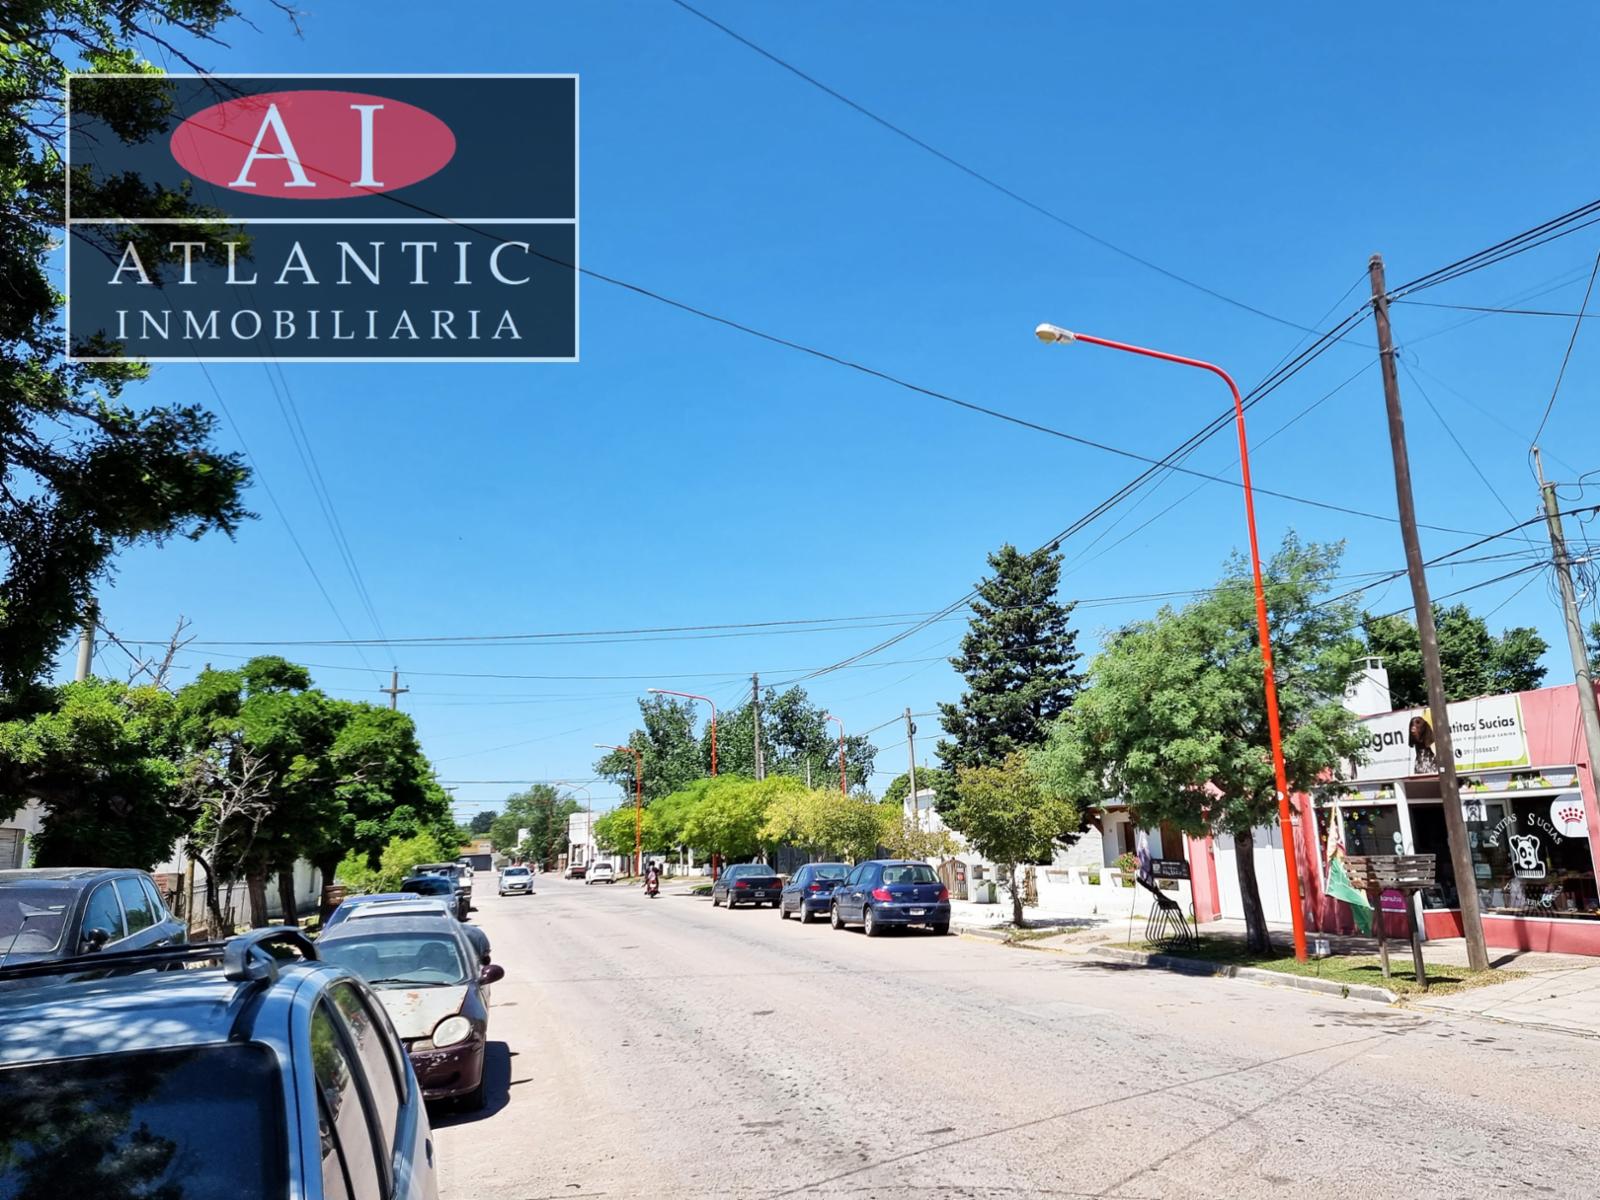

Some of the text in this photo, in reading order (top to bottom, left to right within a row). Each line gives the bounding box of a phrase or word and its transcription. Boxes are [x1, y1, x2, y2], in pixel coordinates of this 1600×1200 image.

[1478, 716, 1515, 730] Sucias
[1360, 730, 1404, 752] ogan
[1489, 812, 1562, 847] PATITAS SUCIAS
